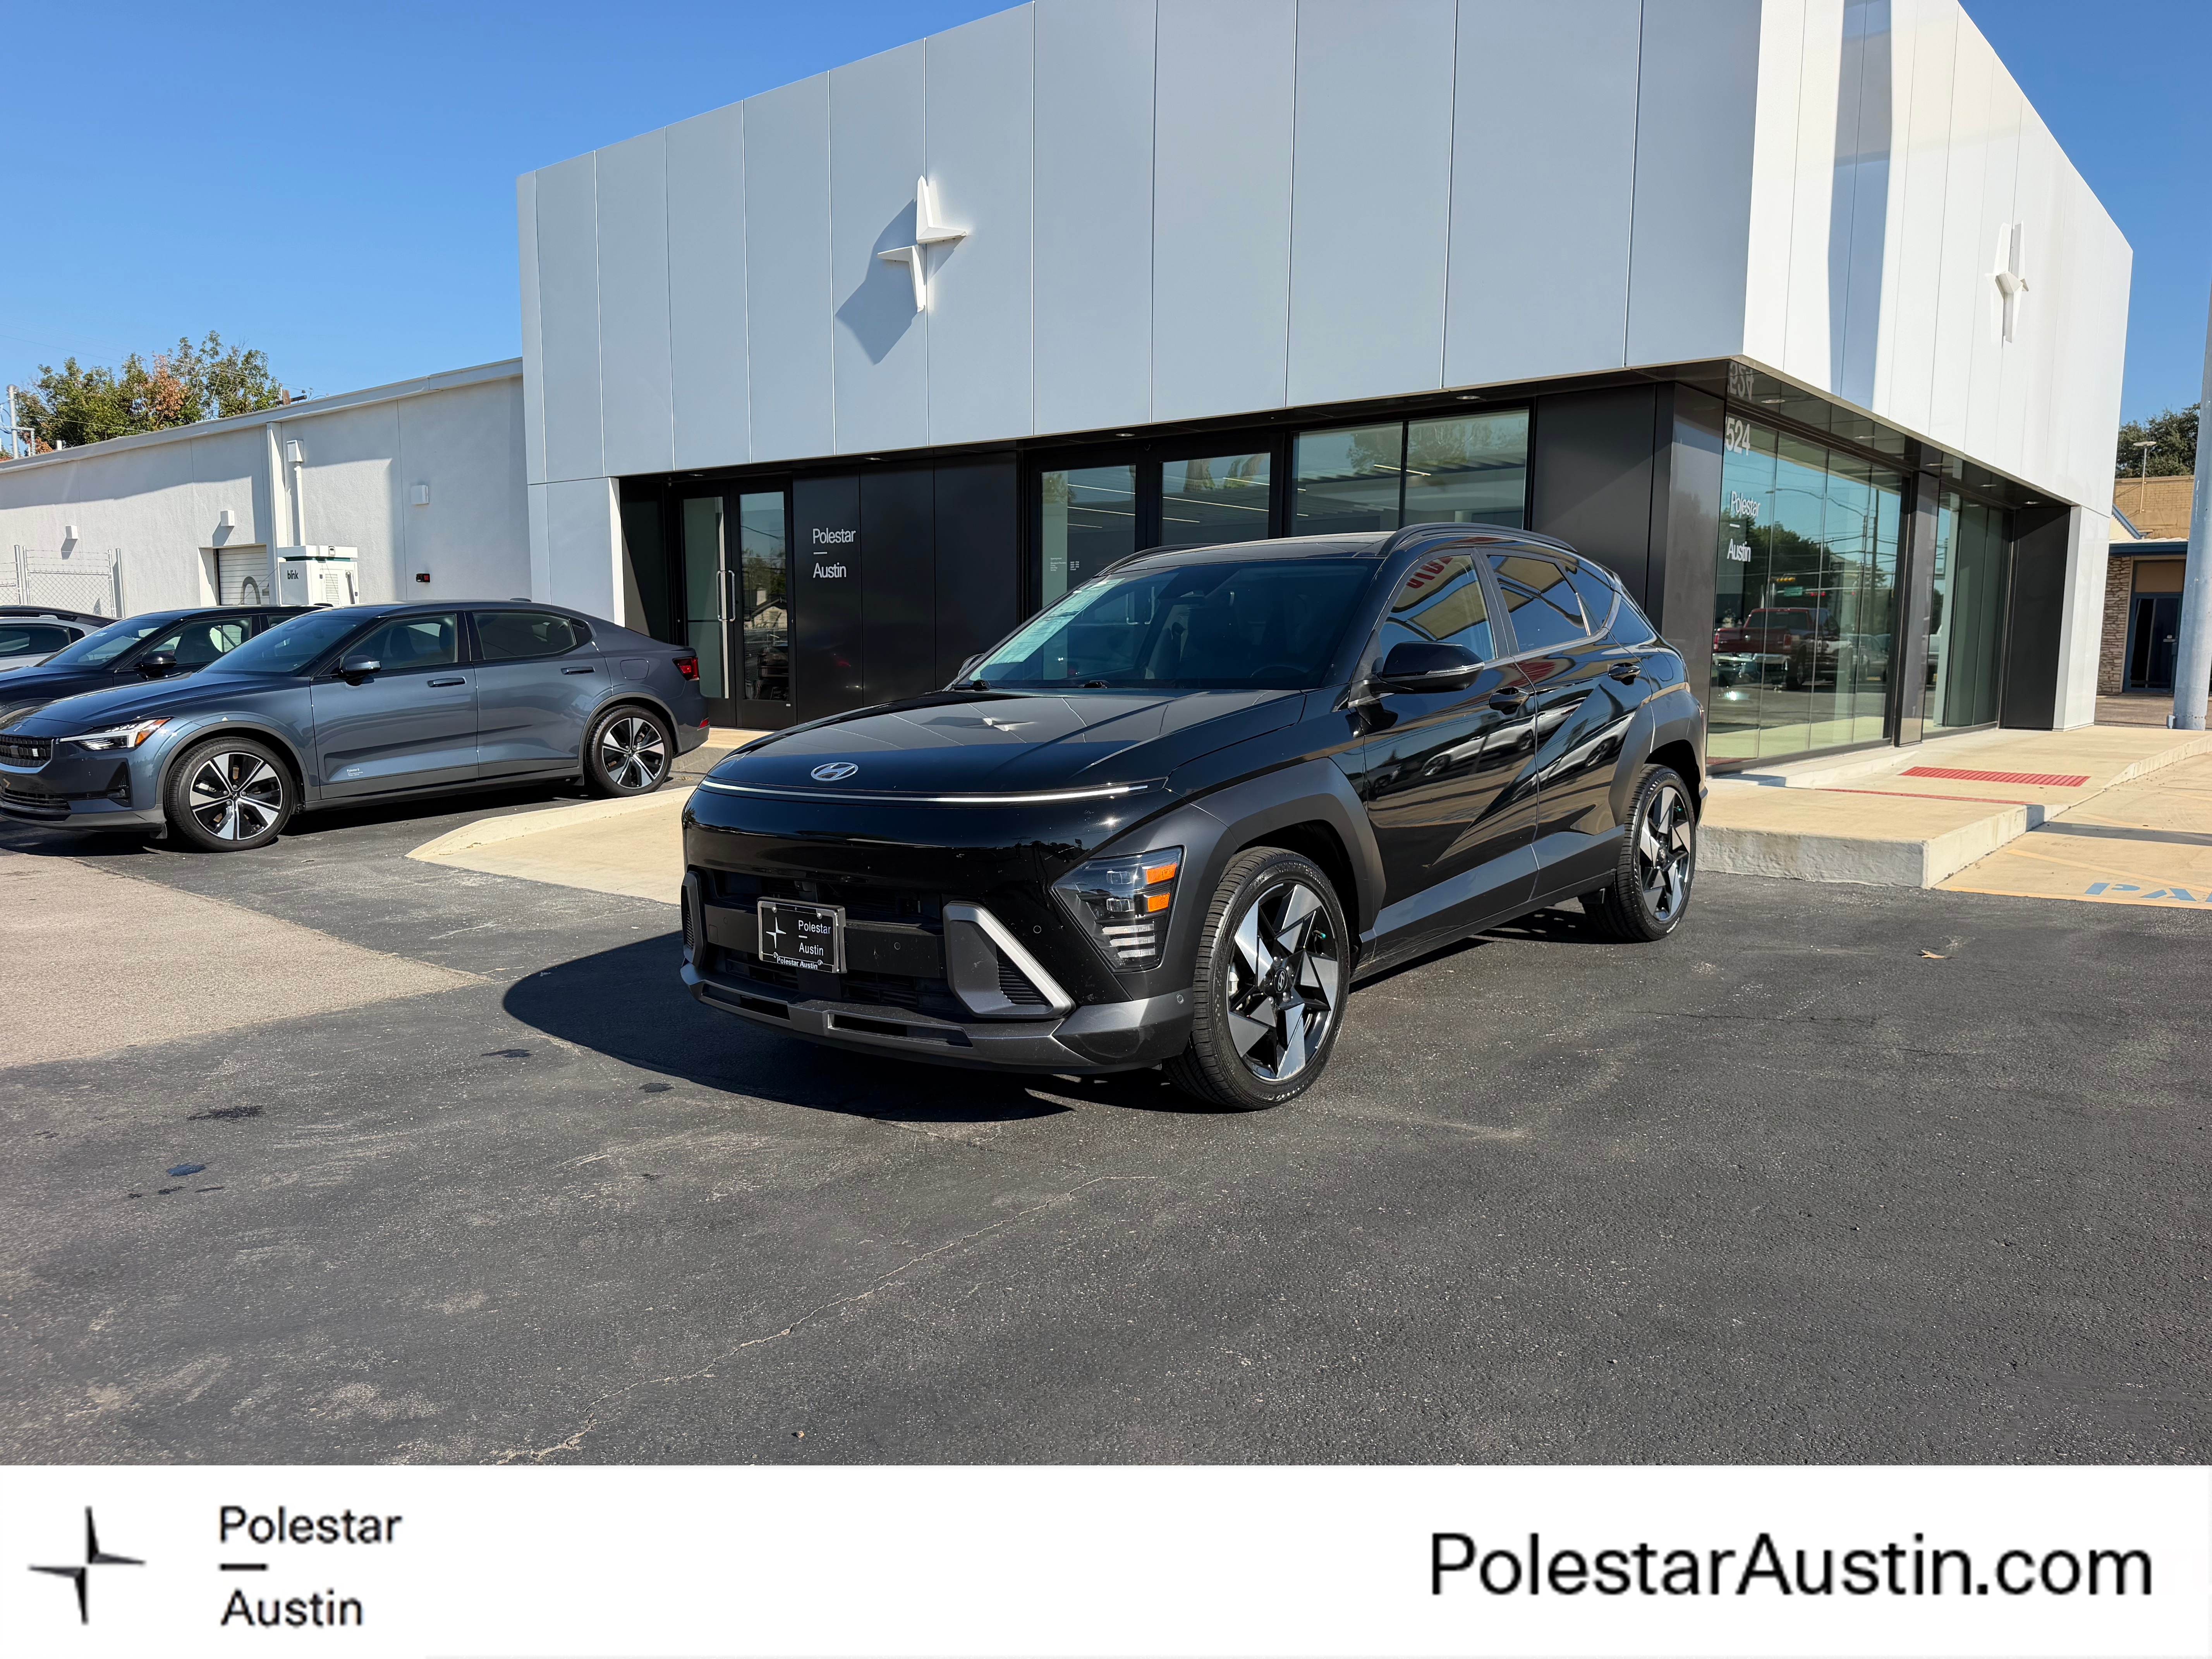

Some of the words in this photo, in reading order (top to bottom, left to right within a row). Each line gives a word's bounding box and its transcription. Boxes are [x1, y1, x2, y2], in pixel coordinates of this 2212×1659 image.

[1725, 416, 1750, 456] 524
[1730, 491, 1760, 517] Polestar
[812, 527, 856, 544] Polestar
[1727, 538, 1751, 562] Austin
[287, 570, 299, 580] blink
[812, 562, 847, 579] Austin
[798, 920, 831, 934] Polestar
[799, 942, 824, 956] Austin
[776, 957, 799, 966] Polestar
[800, 961, 818, 970] Austin
